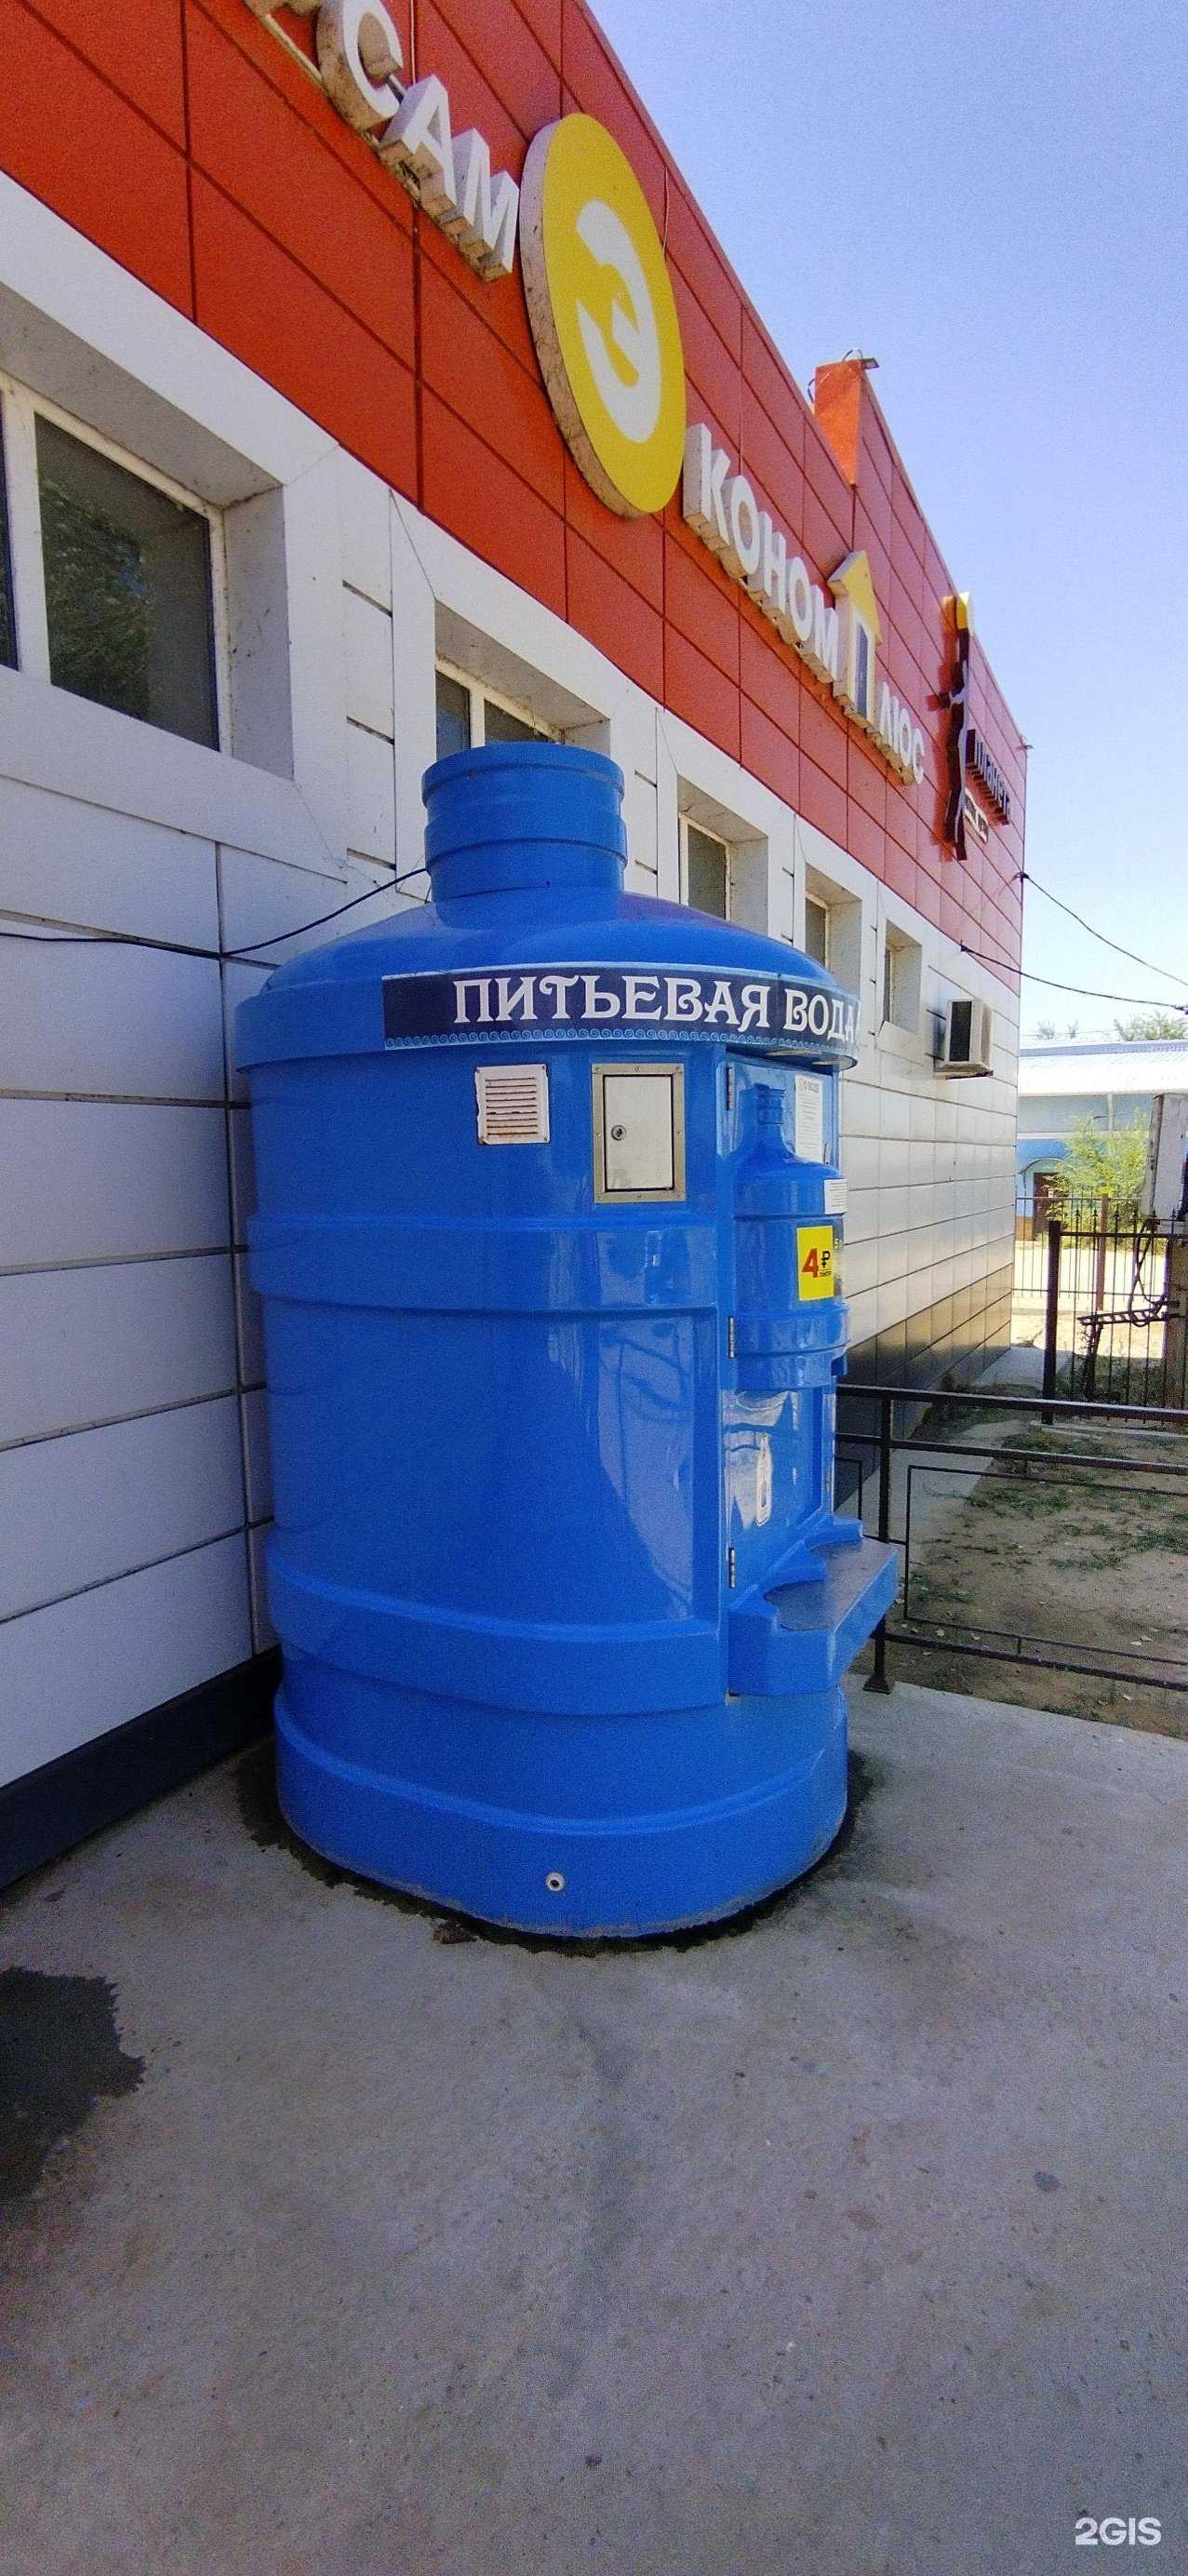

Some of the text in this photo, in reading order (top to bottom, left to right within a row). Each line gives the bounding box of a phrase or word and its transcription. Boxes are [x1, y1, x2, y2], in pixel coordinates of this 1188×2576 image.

[453, 974, 855, 1043] ПИТЬЕВАЯ ВОДА
[801, 1248, 819, 1278] 4
